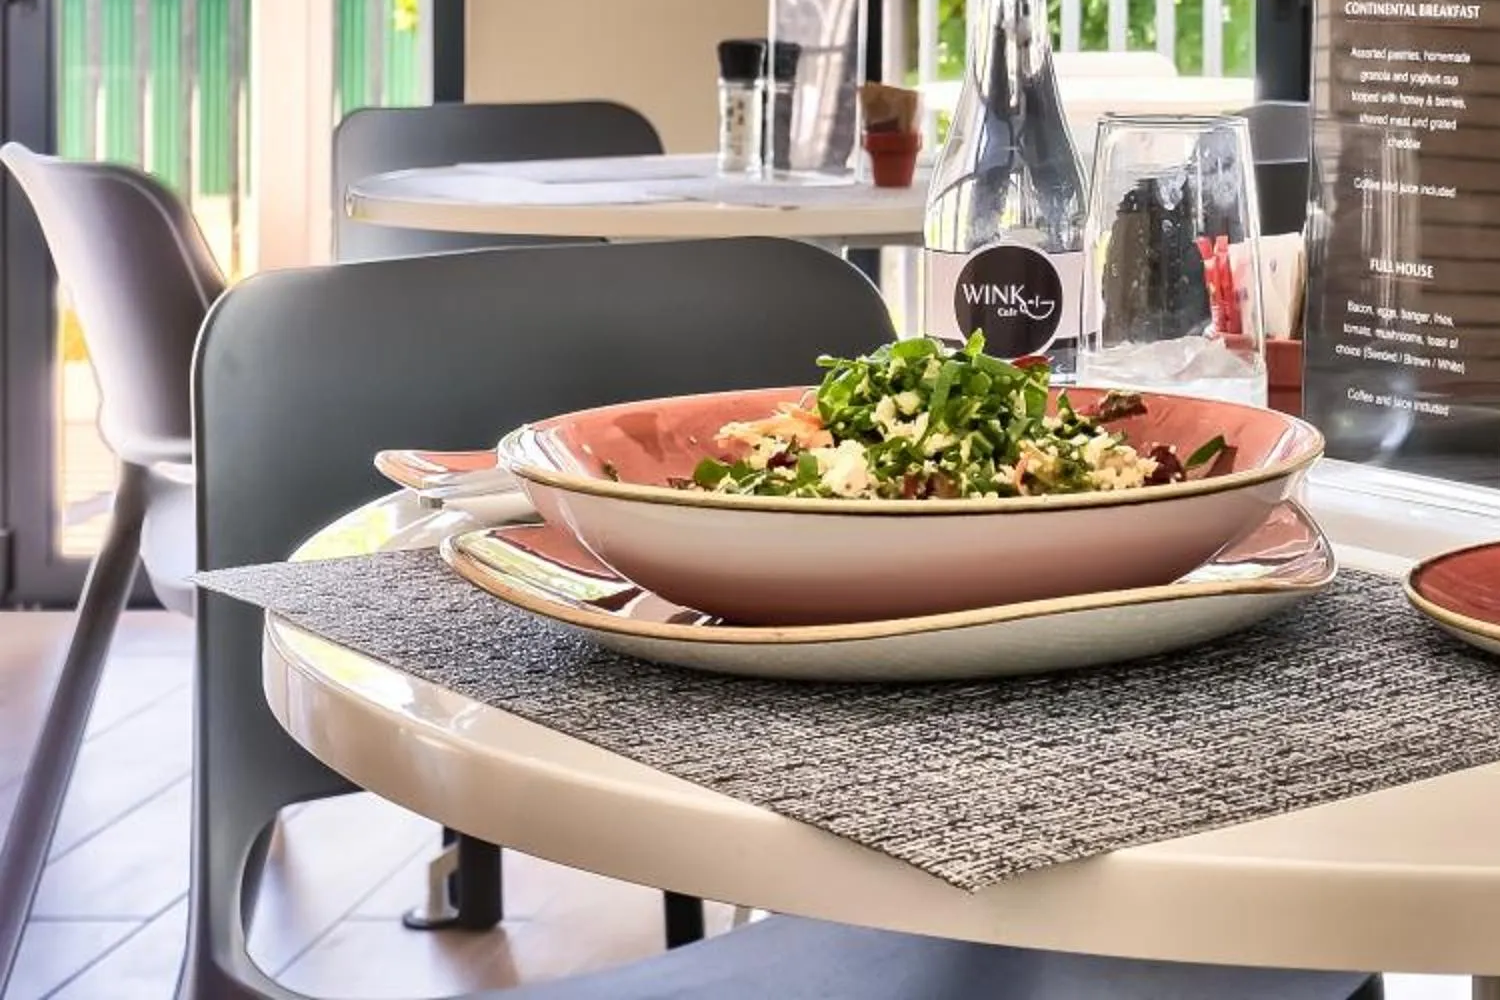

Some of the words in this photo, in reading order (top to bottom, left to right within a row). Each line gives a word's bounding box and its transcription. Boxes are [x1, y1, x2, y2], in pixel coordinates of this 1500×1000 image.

[1345, 2, 1416, 16] CONTINENTAL
[1419, 3, 1480, 18] BREAKFAST
[1360, 70, 1390, 83] granola
[1393, 72, 1408, 82] and
[1410, 73, 1440, 86] yoghurt
[1369, 258, 1394, 273] FULL
[1396, 262, 1434, 278] HOUSE
[962, 283, 1029, 313] WINK
